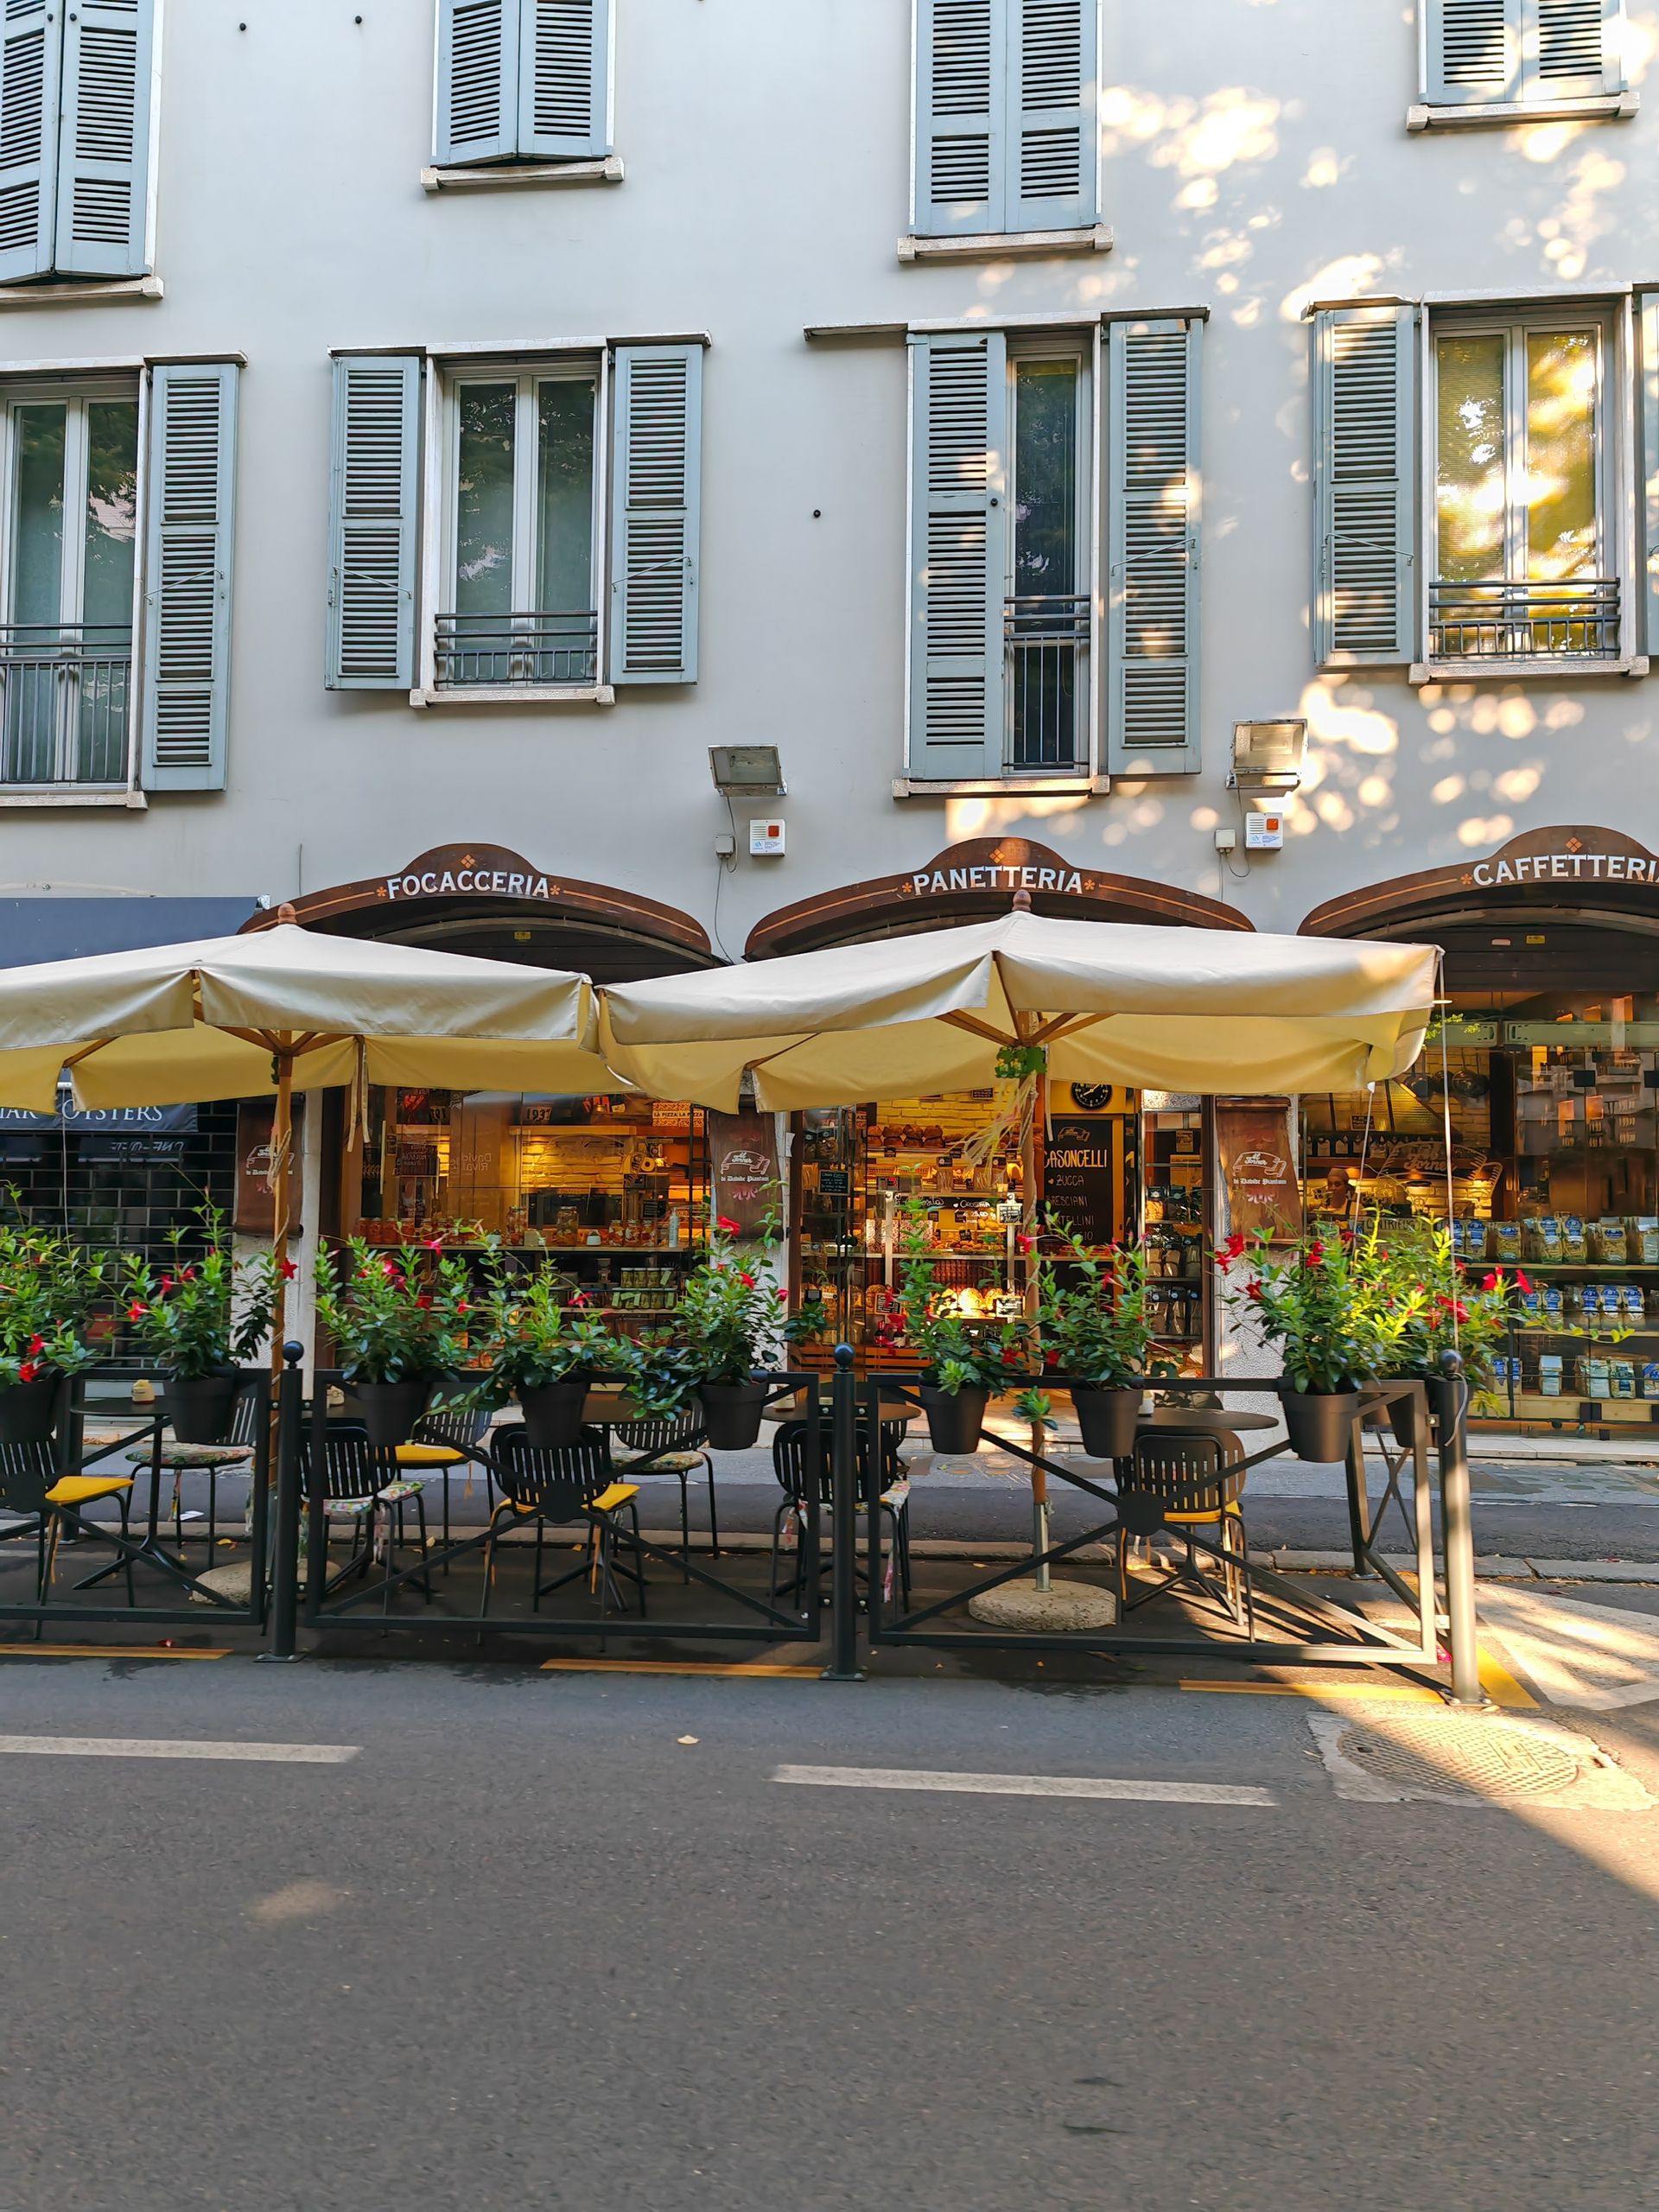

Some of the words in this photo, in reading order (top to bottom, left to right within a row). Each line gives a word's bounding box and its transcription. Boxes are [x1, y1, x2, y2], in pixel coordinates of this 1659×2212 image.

[387, 869, 550, 899] FOCACCERIA
[912, 865, 1084, 896] PANETTERIA
[1472, 854, 1659, 886] CAFFETTERI
[1056, 1174, 1084, 1187] ZUCCA
